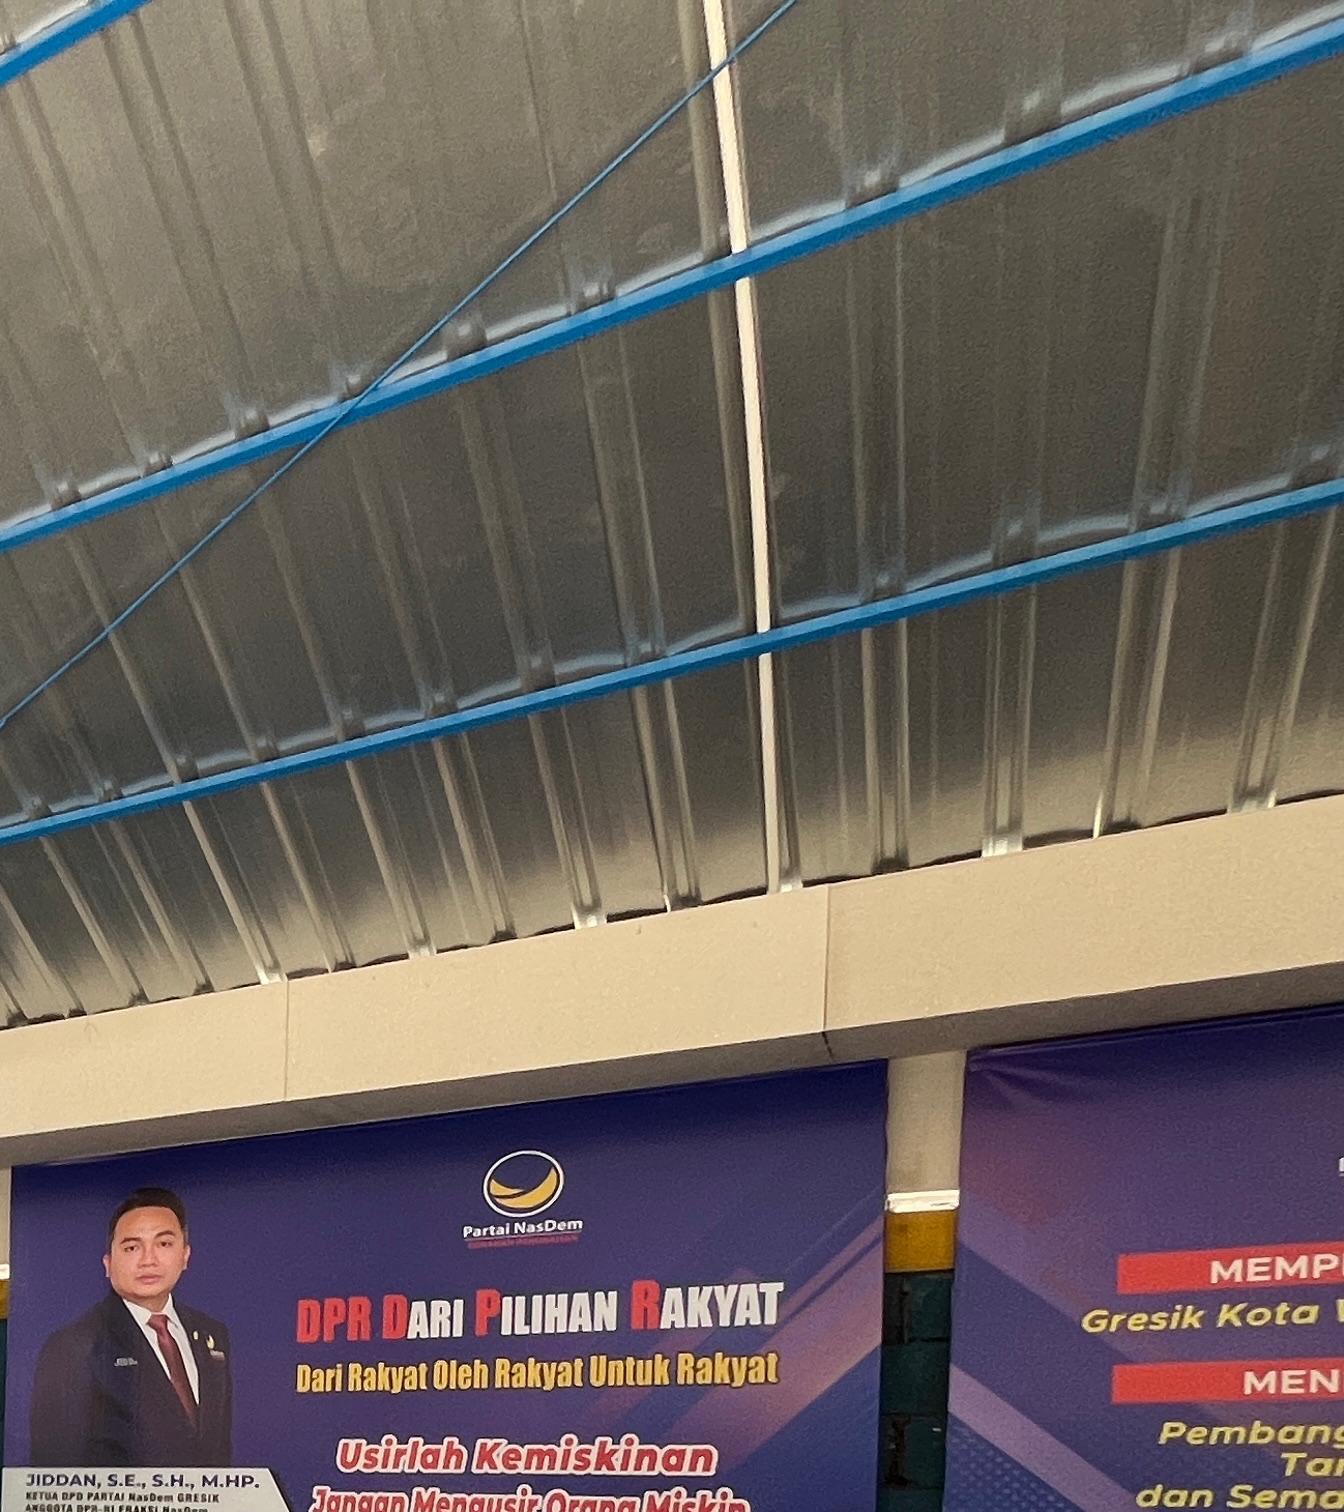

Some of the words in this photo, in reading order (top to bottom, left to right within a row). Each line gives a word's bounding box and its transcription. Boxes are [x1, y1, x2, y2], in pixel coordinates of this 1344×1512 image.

[463, 1223, 510, 1238] Partai
[514, 1219, 584, 1234] NasDem
[1210, 1253, 1344, 1284] MEMP
[295, 1295, 371, 1343] DPR
[382, 1294, 463, 1341] DARI
[474, 1288, 617, 1337] PILIHAN
[630, 1279, 785, 1331] RAKYAT
[1081, 1304, 1207, 1333] Gresik
[1216, 1302, 1320, 1328] Kota
[296, 1363, 343, 1393] Dari
[347, 1361, 428, 1394] Rakyat
[433, 1358, 489, 1390] Oleh
[494, 1356, 583, 1392] Rakyat
[589, 1353, 670, 1386] Untuk
[676, 1351, 779, 1388] Rakyat
[337, 1433, 468, 1473] Usirlah
[473, 1432, 719, 1476] Kemiskinan
[25, 1473, 102, 1489] JIDDAN,
[107, 1473, 146, 1488] S.E.,
[151, 1474, 195, 1489] S.H.,
[201, 1474, 260, 1489] M.HP.
[1135, 1484, 1214, 1508] dan
[25, 1491, 59, 1502] KETUA
[87, 1492, 125, 1502] PARTAI
[128, 1493, 174, 1503] NasDem
[177, 1493, 220, 1503] GRESIK
